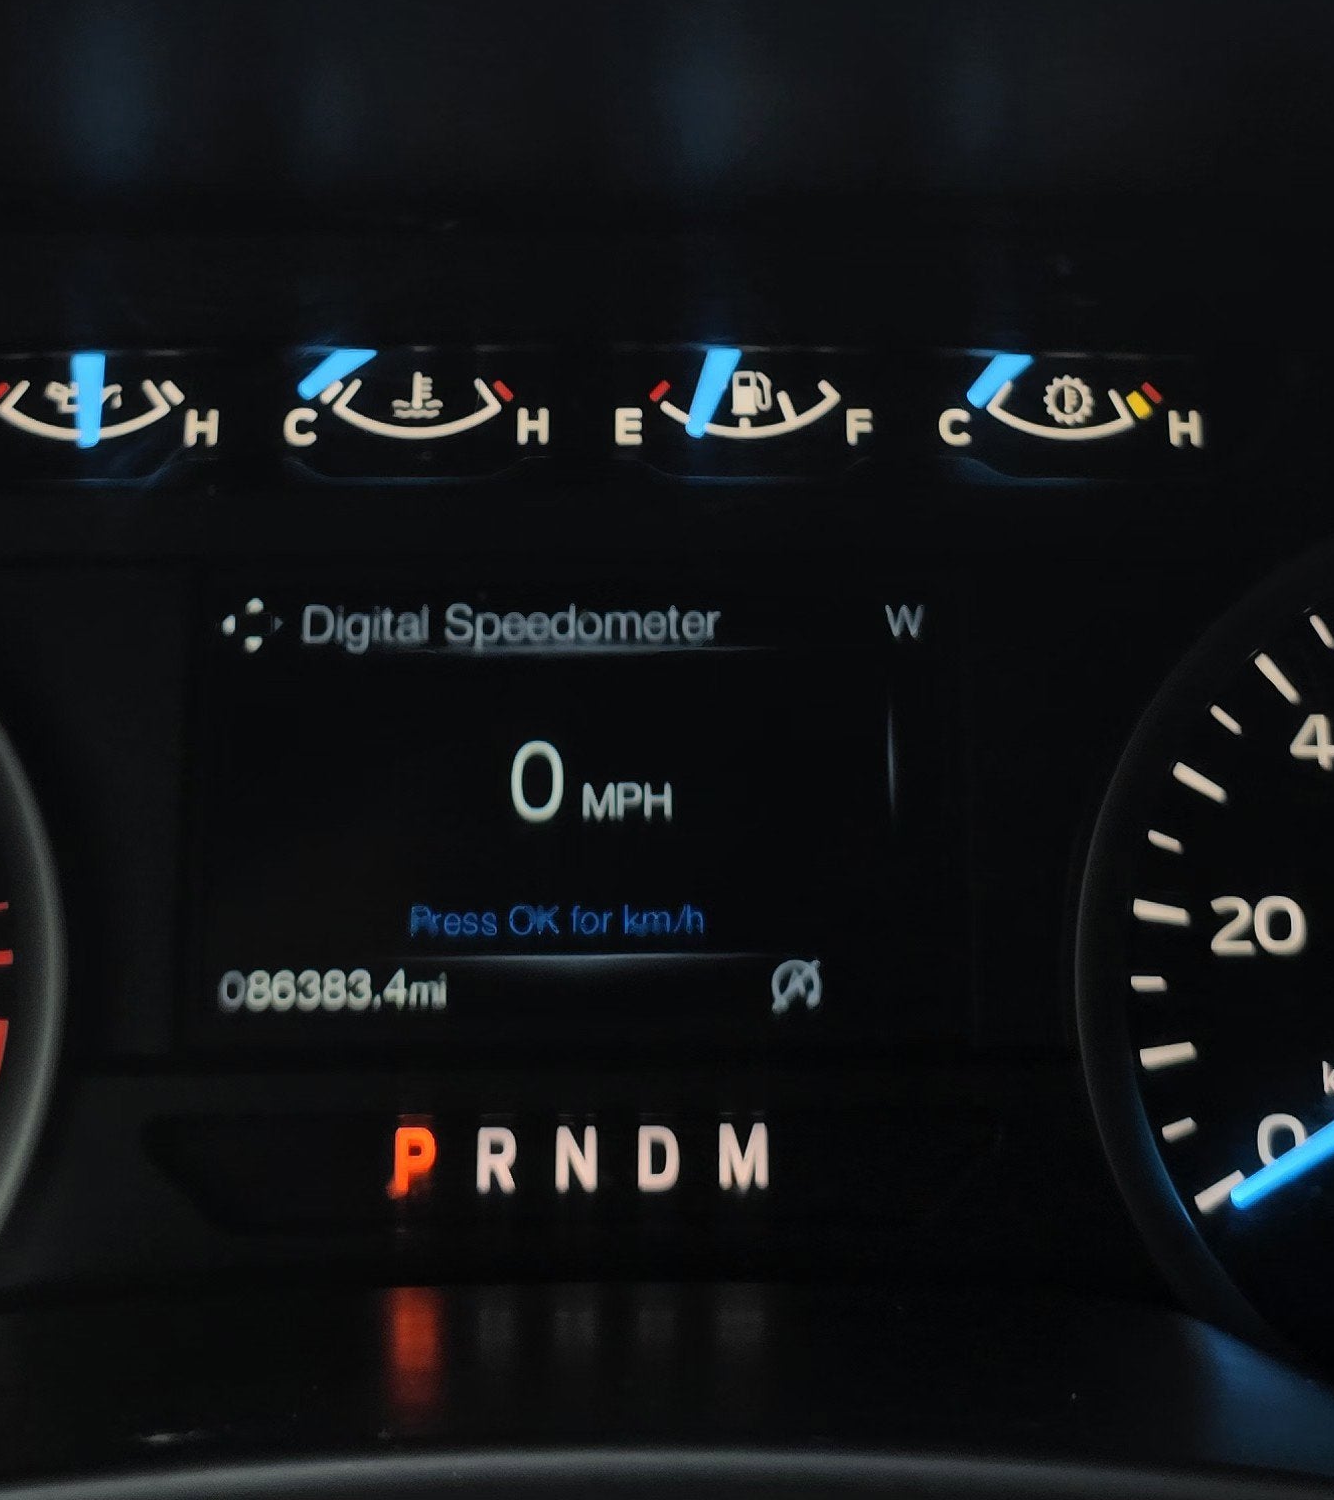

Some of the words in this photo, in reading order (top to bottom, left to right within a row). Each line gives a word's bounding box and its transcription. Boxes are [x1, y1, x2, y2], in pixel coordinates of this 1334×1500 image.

[182, 408, 220, 448] H
[283, 407, 319, 447] C
[516, 407, 551, 446] H
[614, 407, 644, 446] E
[846, 407, 874, 447] F
[937, 407, 972, 446] C
[1167, 409, 1204, 447] H
[301, 603, 430, 654] Digital
[444, 603, 721, 648] Speedometer
[884, 604, 925, 638] W
[510, 739, 565, 822] 0
[582, 781, 673, 821] MPH
[409, 904, 498, 937] Press
[508, 905, 561, 936] OK
[569, 904, 613, 936] for
[623, 904, 705, 937] km/h
[1210, 895, 1308, 956] 20
[393, 1125, 438, 1192] P
[476, 1125, 517, 1193] R
[554, 1125, 598, 1193] N
[636, 1125, 680, 1193] D
[718, 1122, 770, 1191] M
[1257, 1112, 1308, 1168] 0
